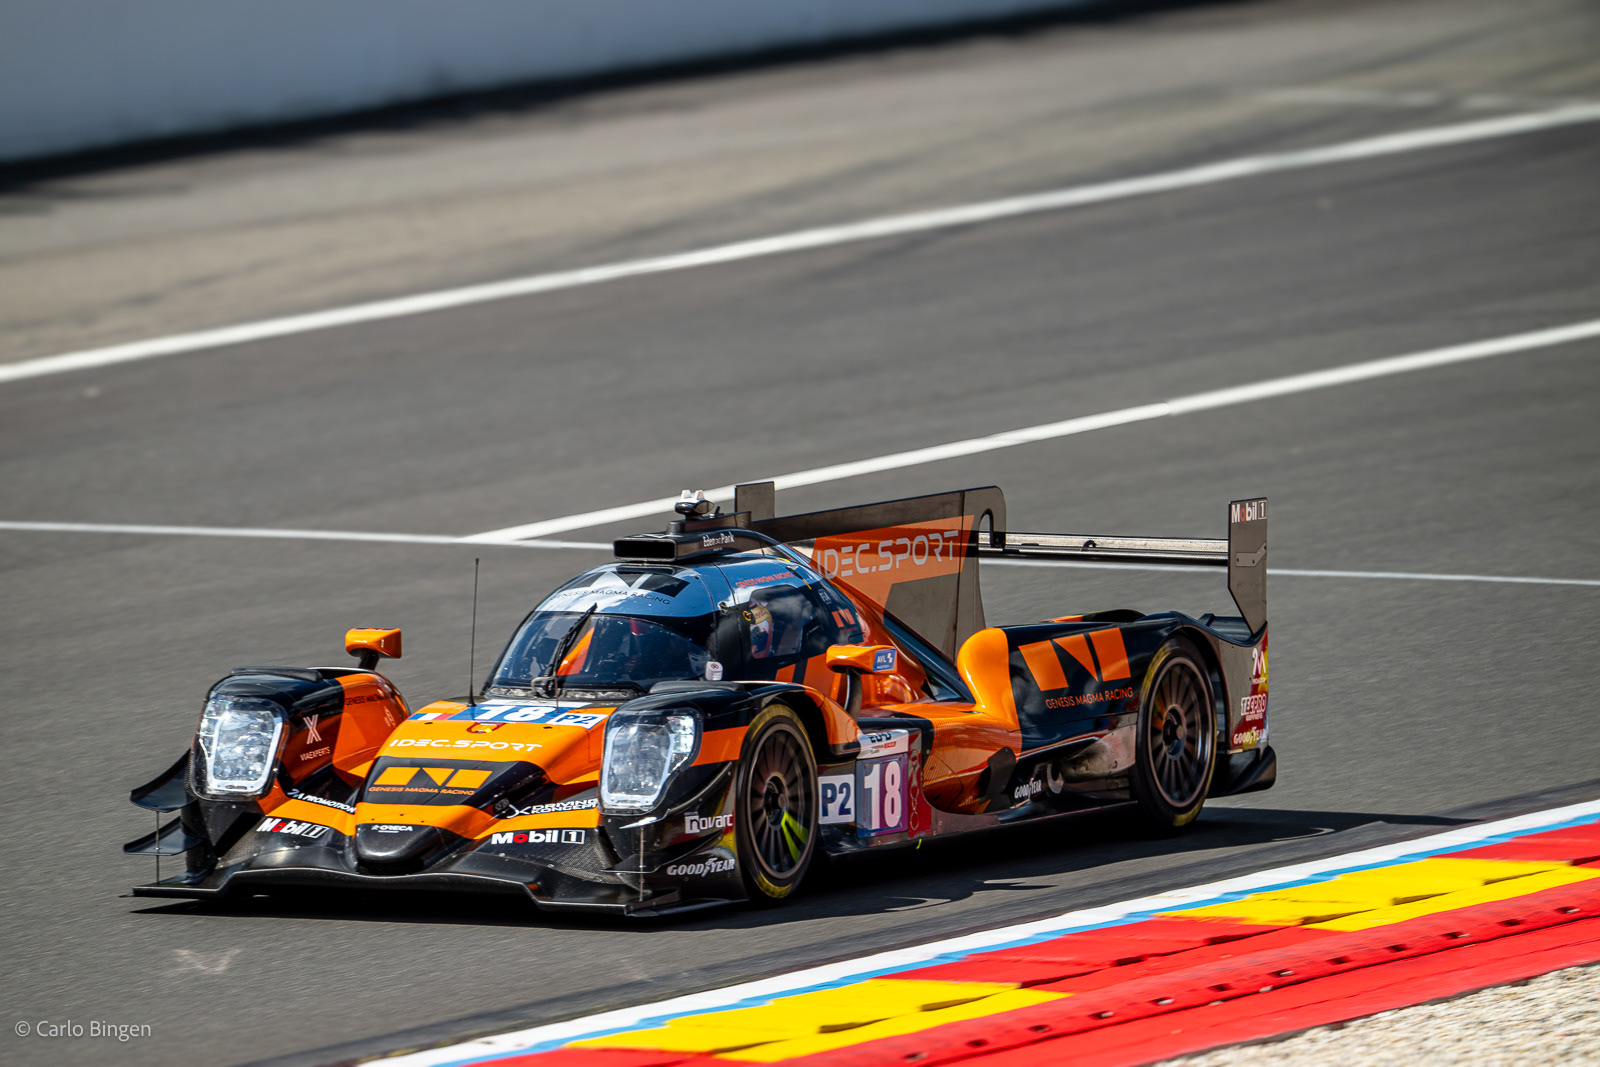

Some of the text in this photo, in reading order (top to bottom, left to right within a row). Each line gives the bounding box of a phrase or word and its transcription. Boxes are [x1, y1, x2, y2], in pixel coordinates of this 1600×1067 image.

[1231, 501, 1257, 523] Mobil
[719, 531, 735, 544] Park
[817, 530, 959, 580] IDEC.SPORT
[630, 591, 671, 605] RACING
[876, 654, 887, 664] AVL
[1045, 686, 1134, 709] GENESIS MAGMA RACING
[474, 705, 597, 724] 18 P2
[300, 746, 330, 761] VIAEXPERTS
[389, 739, 543, 752] IDEC.SPORT
[440, 788, 476, 796] RACING
[821, 782, 852, 817] P2
[864, 760, 902, 830] 18
[256, 818, 309, 836] Mobil
[379, 824, 413, 832] ORECA
[491, 830, 559, 844] Mobil
[666, 857, 736, 877] GOODYEAR
